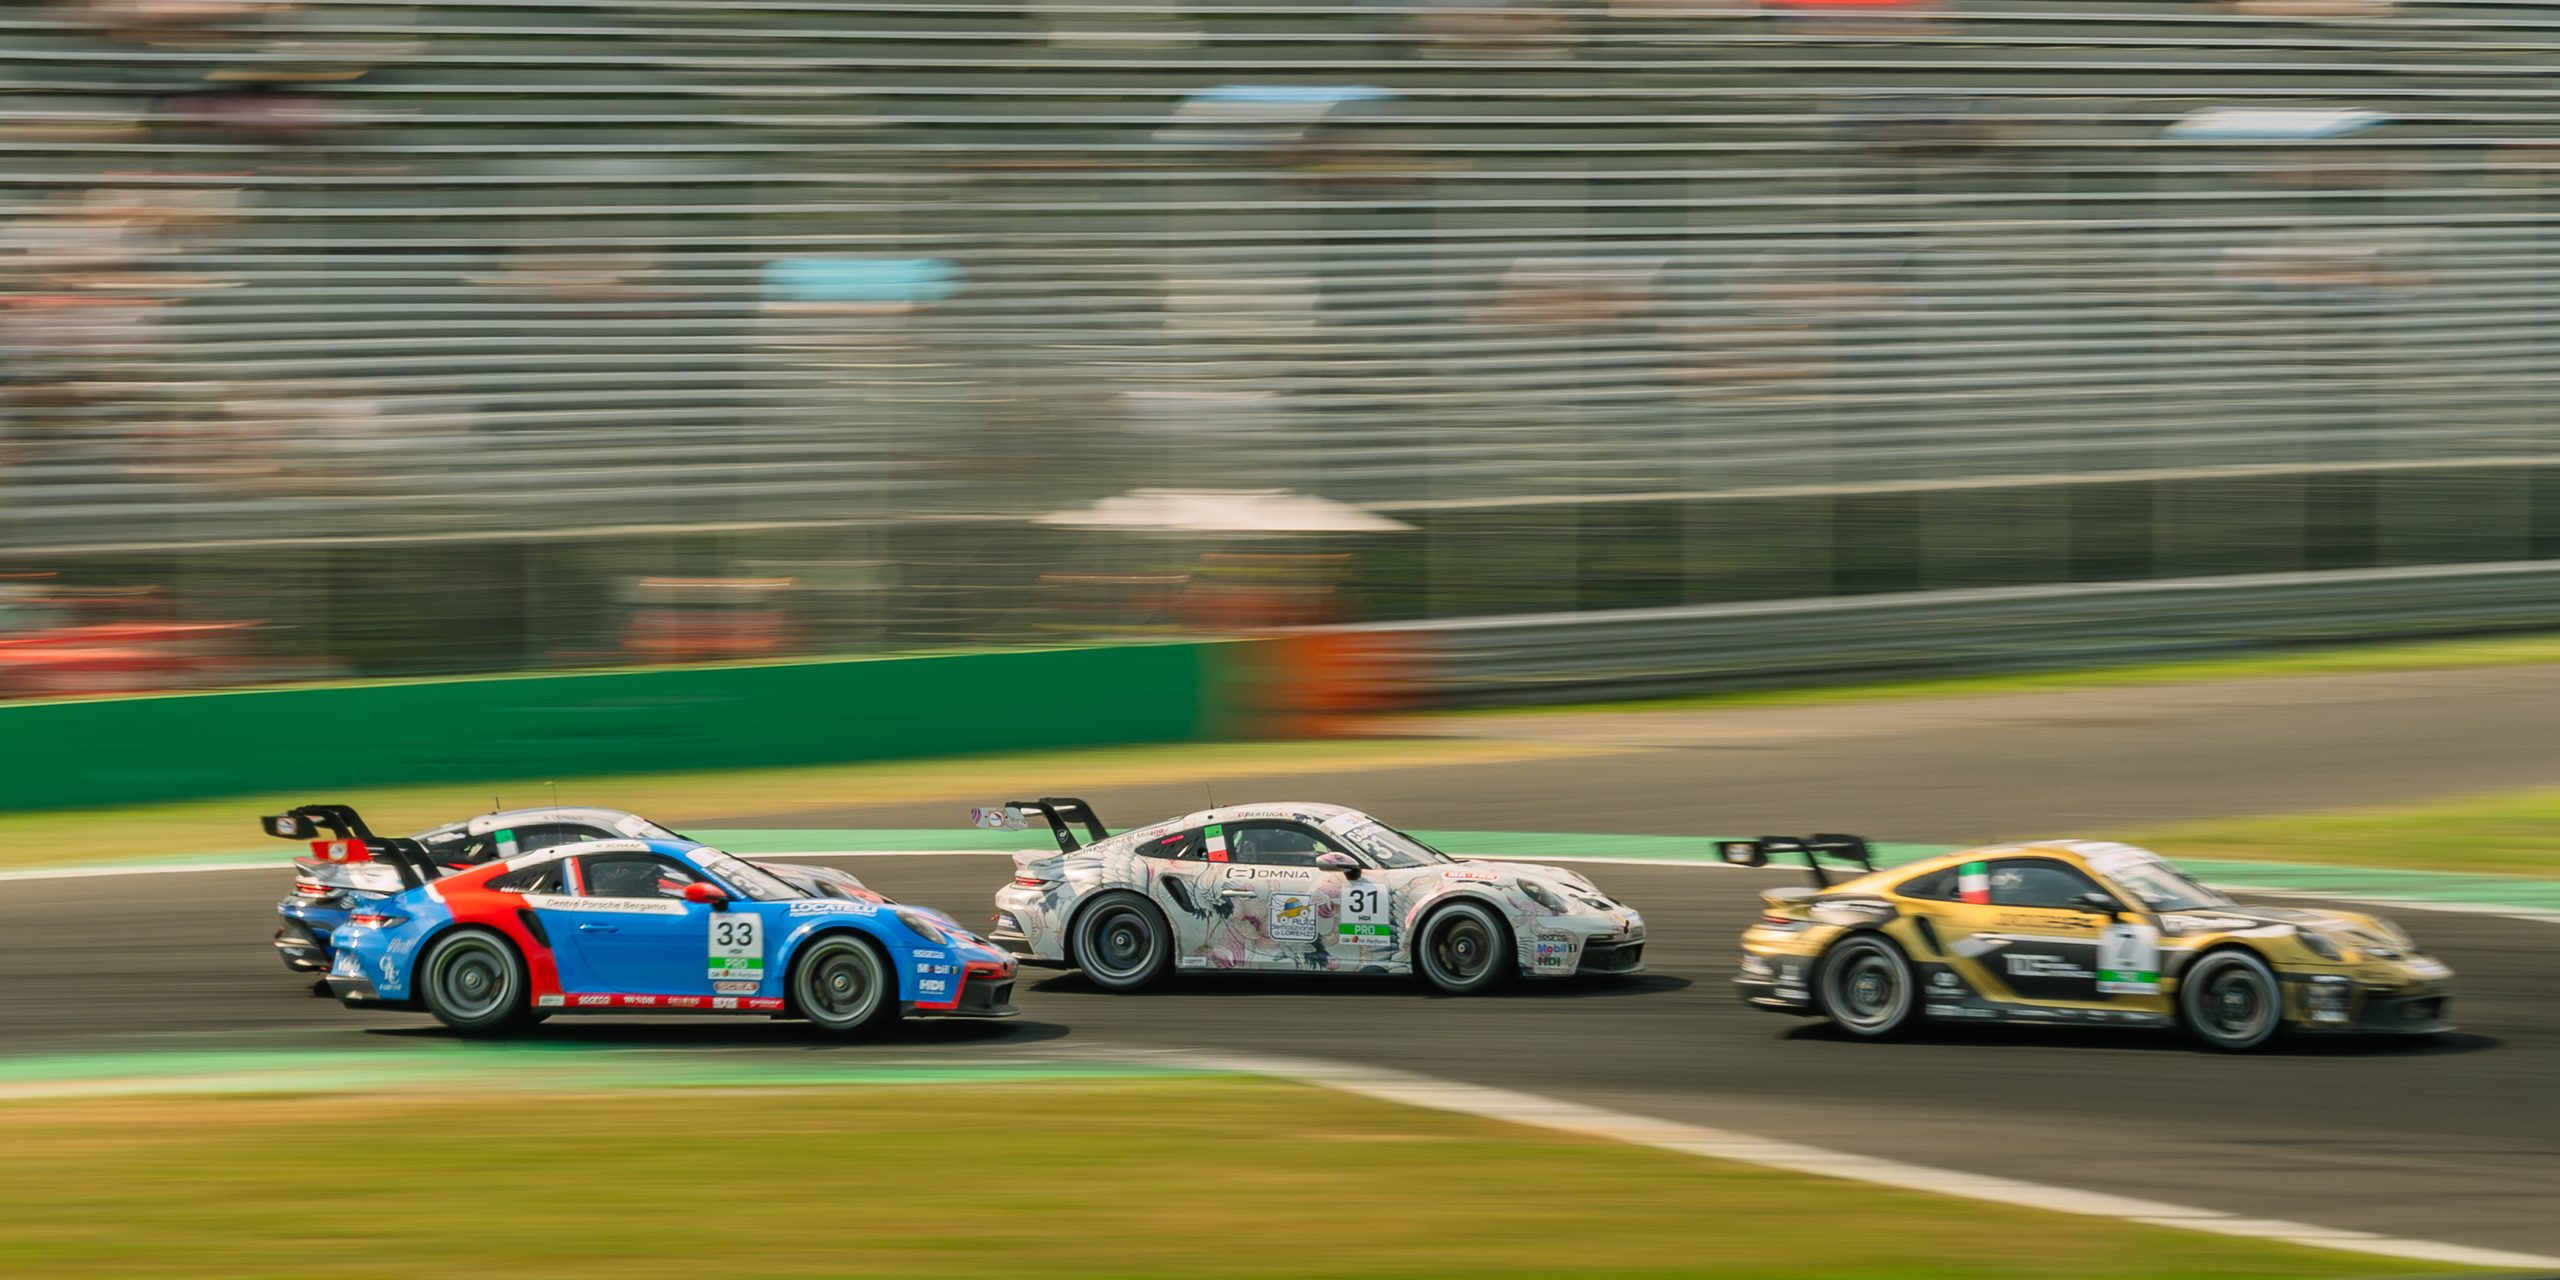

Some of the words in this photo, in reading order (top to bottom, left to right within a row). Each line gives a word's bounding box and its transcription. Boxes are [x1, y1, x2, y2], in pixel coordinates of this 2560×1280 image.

[1136, 827, 1164, 839] Milano
[1257, 869, 1310, 879] OMNIA
[581, 900, 621, 909] Porsche
[622, 901, 667, 912] Bergamo
[1349, 889, 1378, 914] 31
[717, 922, 752, 946] 33
[1354, 925, 1376, 935] PRO
[1537, 944, 1567, 953] Mobil
[725, 959, 748, 969] PRO
[1538, 957, 1561, 966] HDI
[919, 980, 945, 991] HDI
